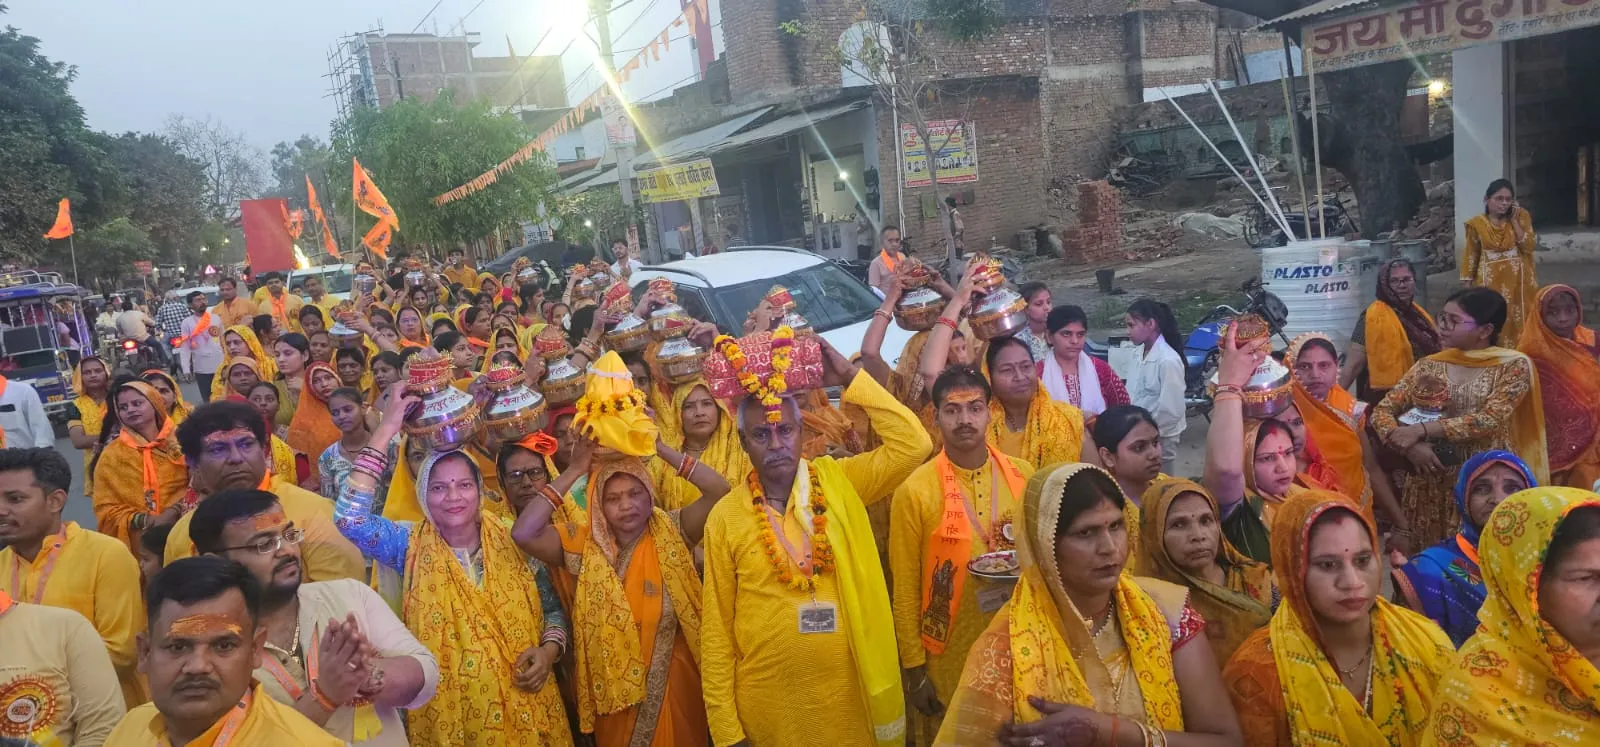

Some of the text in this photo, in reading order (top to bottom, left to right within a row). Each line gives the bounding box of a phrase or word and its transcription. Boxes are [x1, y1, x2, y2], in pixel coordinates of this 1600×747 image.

[1313, 12, 1390, 54] जय
[1274, 264, 1333, 279] PLASTO
[1304, 281, 1349, 294] PLASTO
